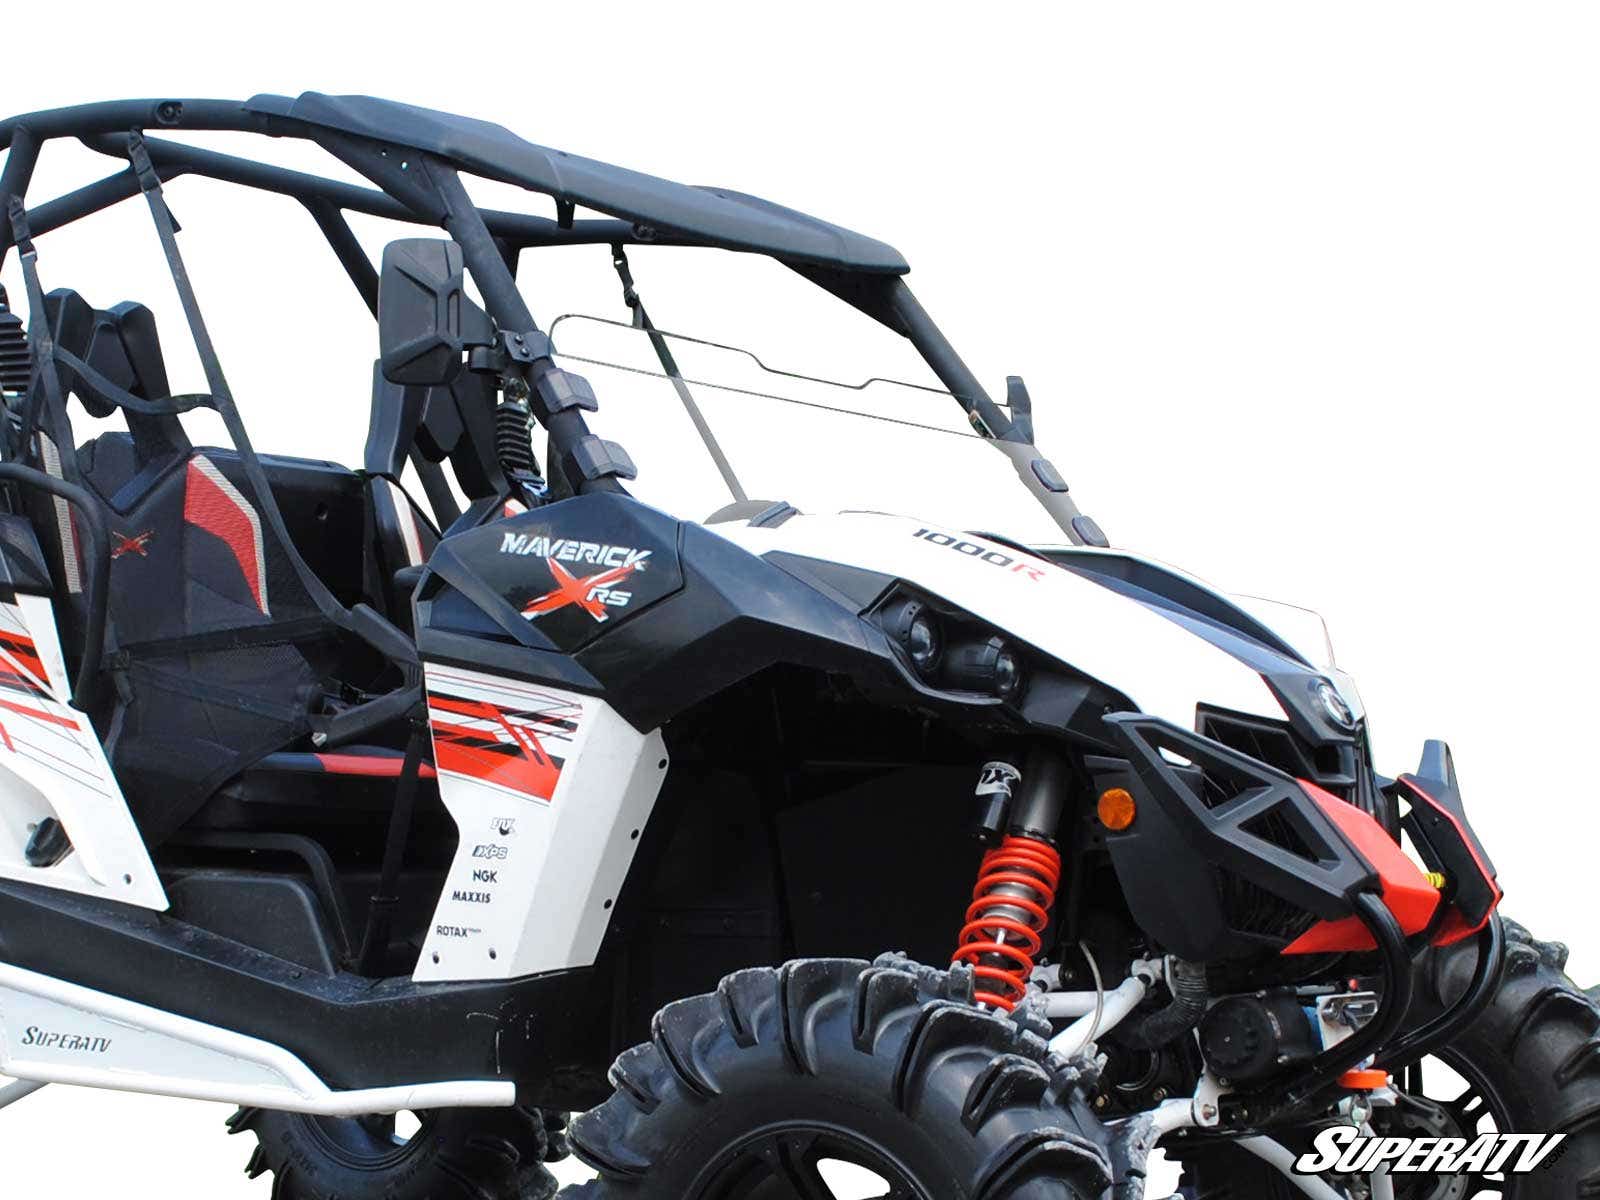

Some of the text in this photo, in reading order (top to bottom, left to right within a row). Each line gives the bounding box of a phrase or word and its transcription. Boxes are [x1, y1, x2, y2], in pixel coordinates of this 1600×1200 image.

[500, 532, 653, 571] MAVERICK
[912, 528, 1047, 582] 1000R
[472, 869, 498, 884] NGK
[451, 890, 492, 904] MAXXIS
[436, 924, 468, 938] ROTAX
